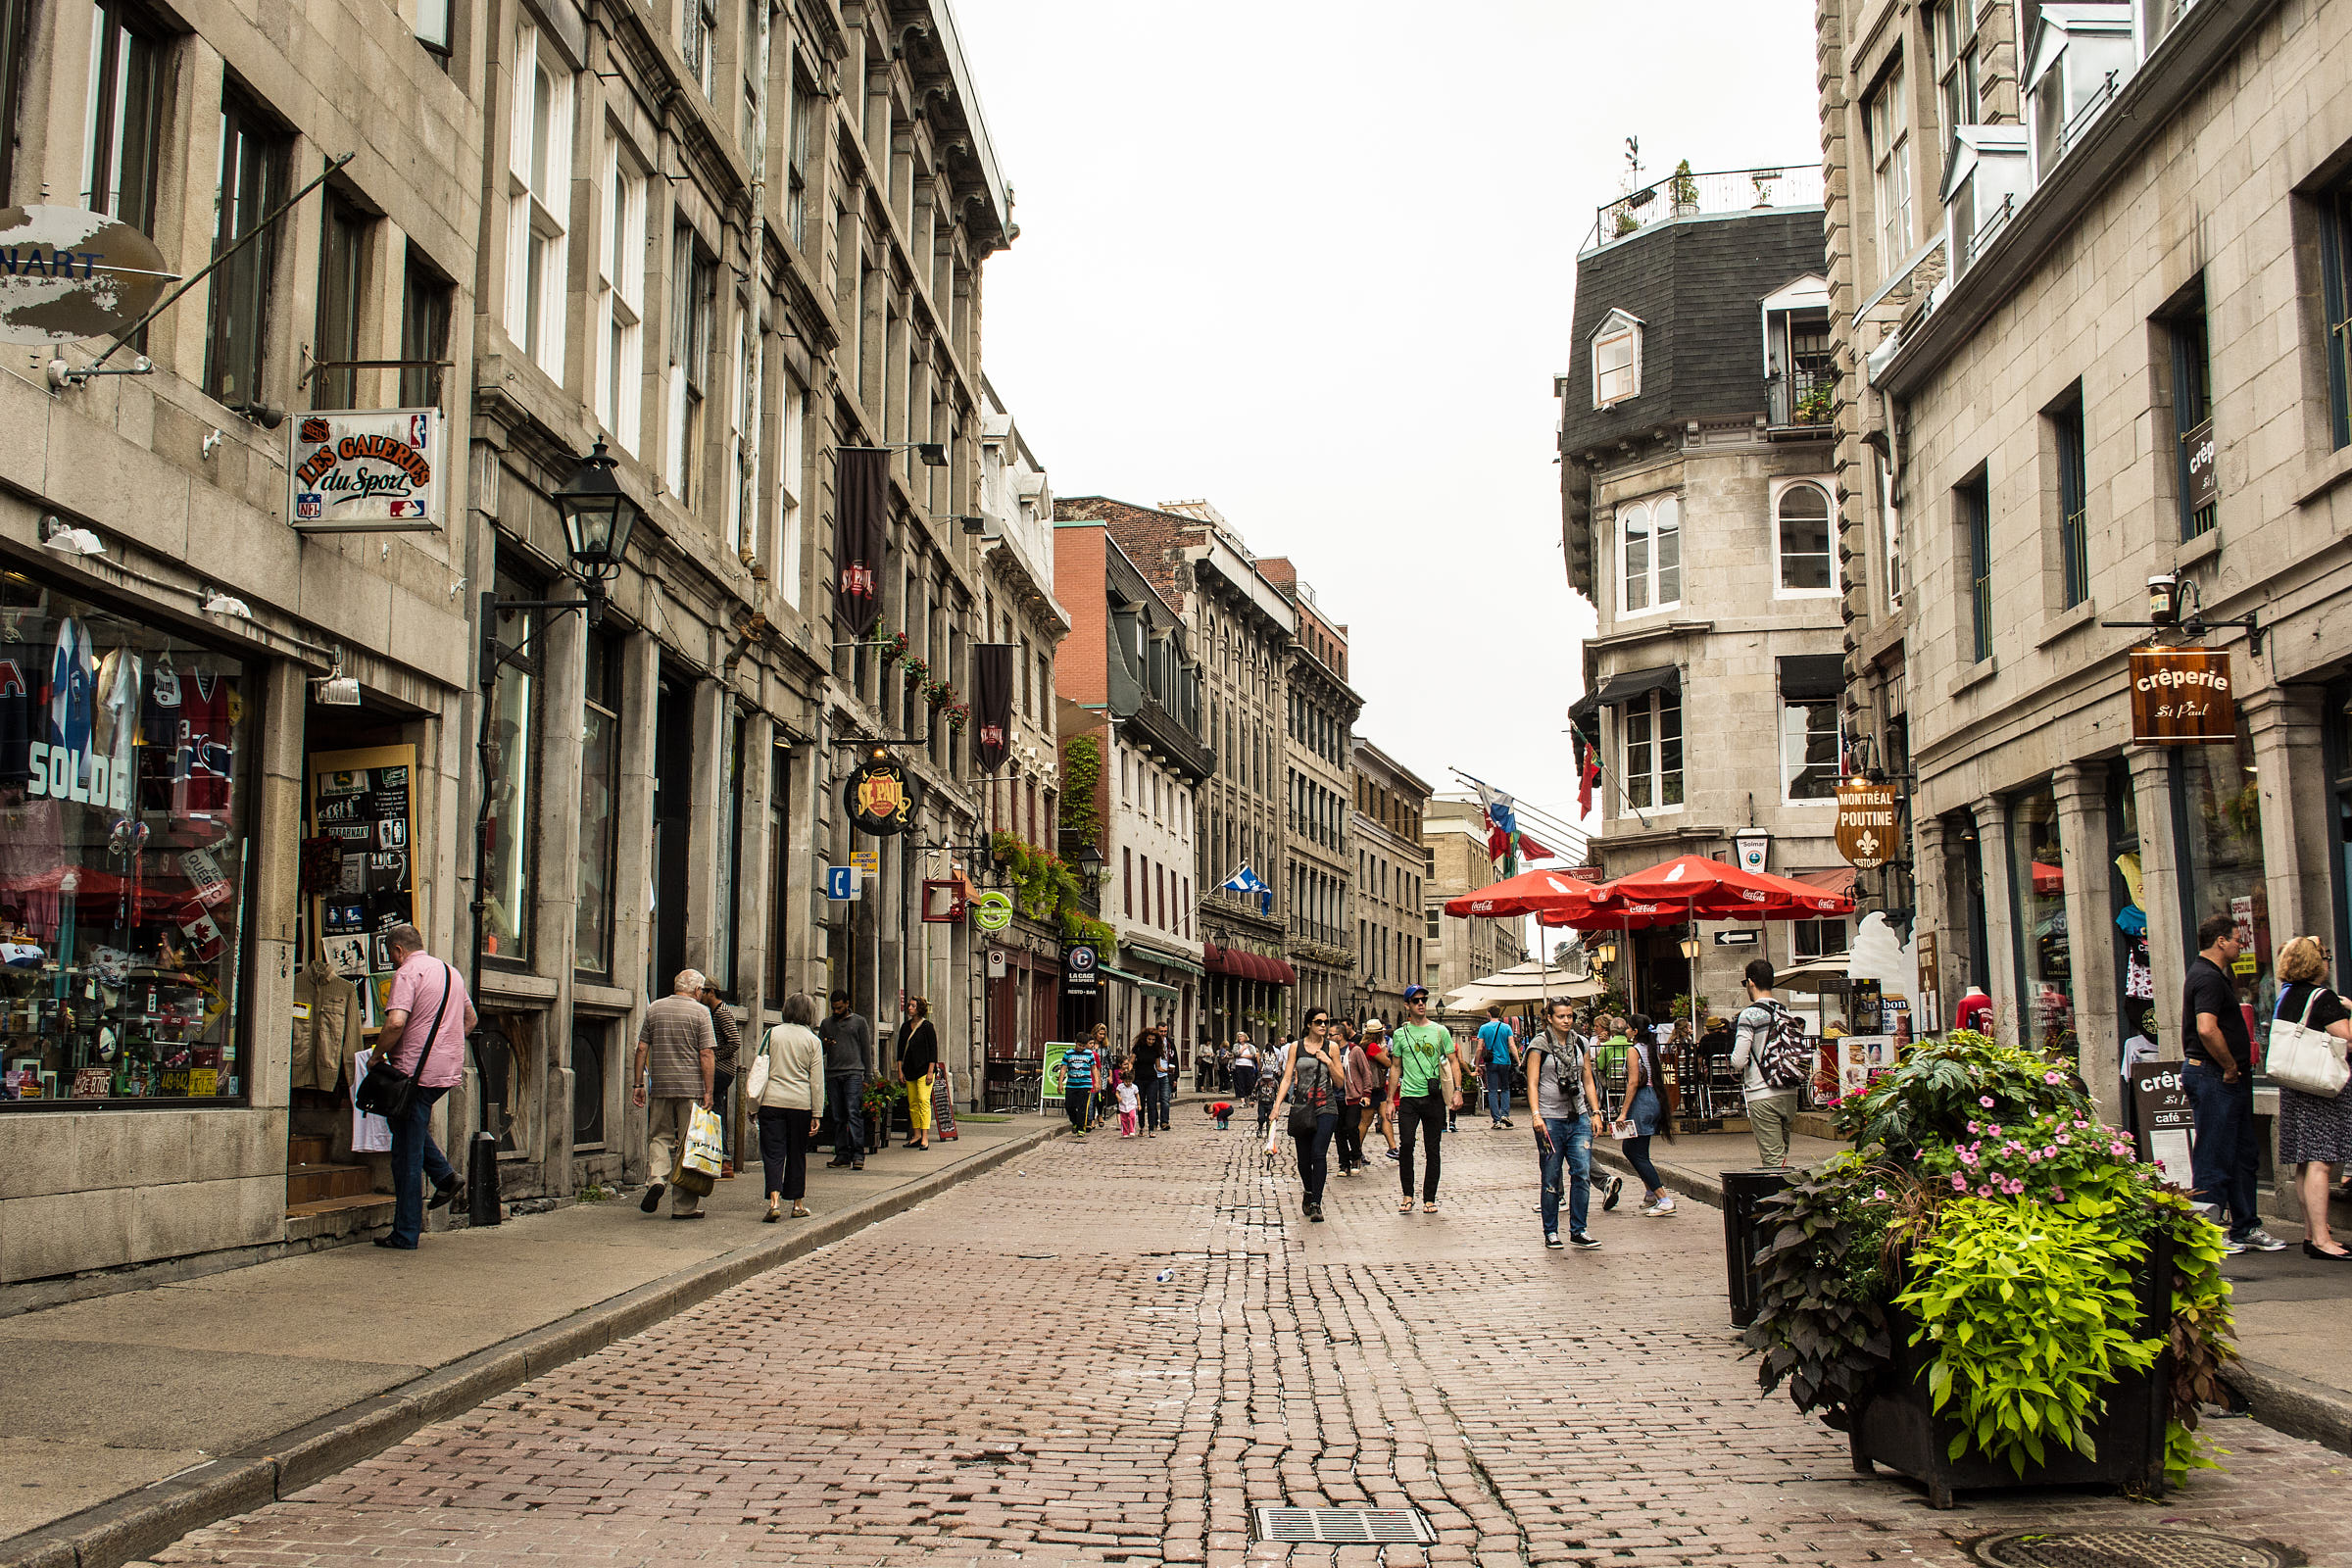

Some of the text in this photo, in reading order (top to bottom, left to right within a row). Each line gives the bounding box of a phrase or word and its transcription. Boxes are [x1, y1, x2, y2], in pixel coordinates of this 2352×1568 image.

[296, 434, 430, 490] LES GALERIES
[320, 466, 412, 500] du Sport
[300, 504, 319, 515] NFL
[2136, 668, 2229, 692] crêperie
[2154, 701, 2210, 719] St Paul
[27, 741, 128, 811] SOLDE
[1838, 790, 1892, 806] MONTRÉAL
[1840, 811, 1892, 827] POUTINE
[188, 854, 222, 900] QUÉBEC
[1860, 1000, 1908, 1013] Qubon
[2155, 1112, 2180, 1124] café
